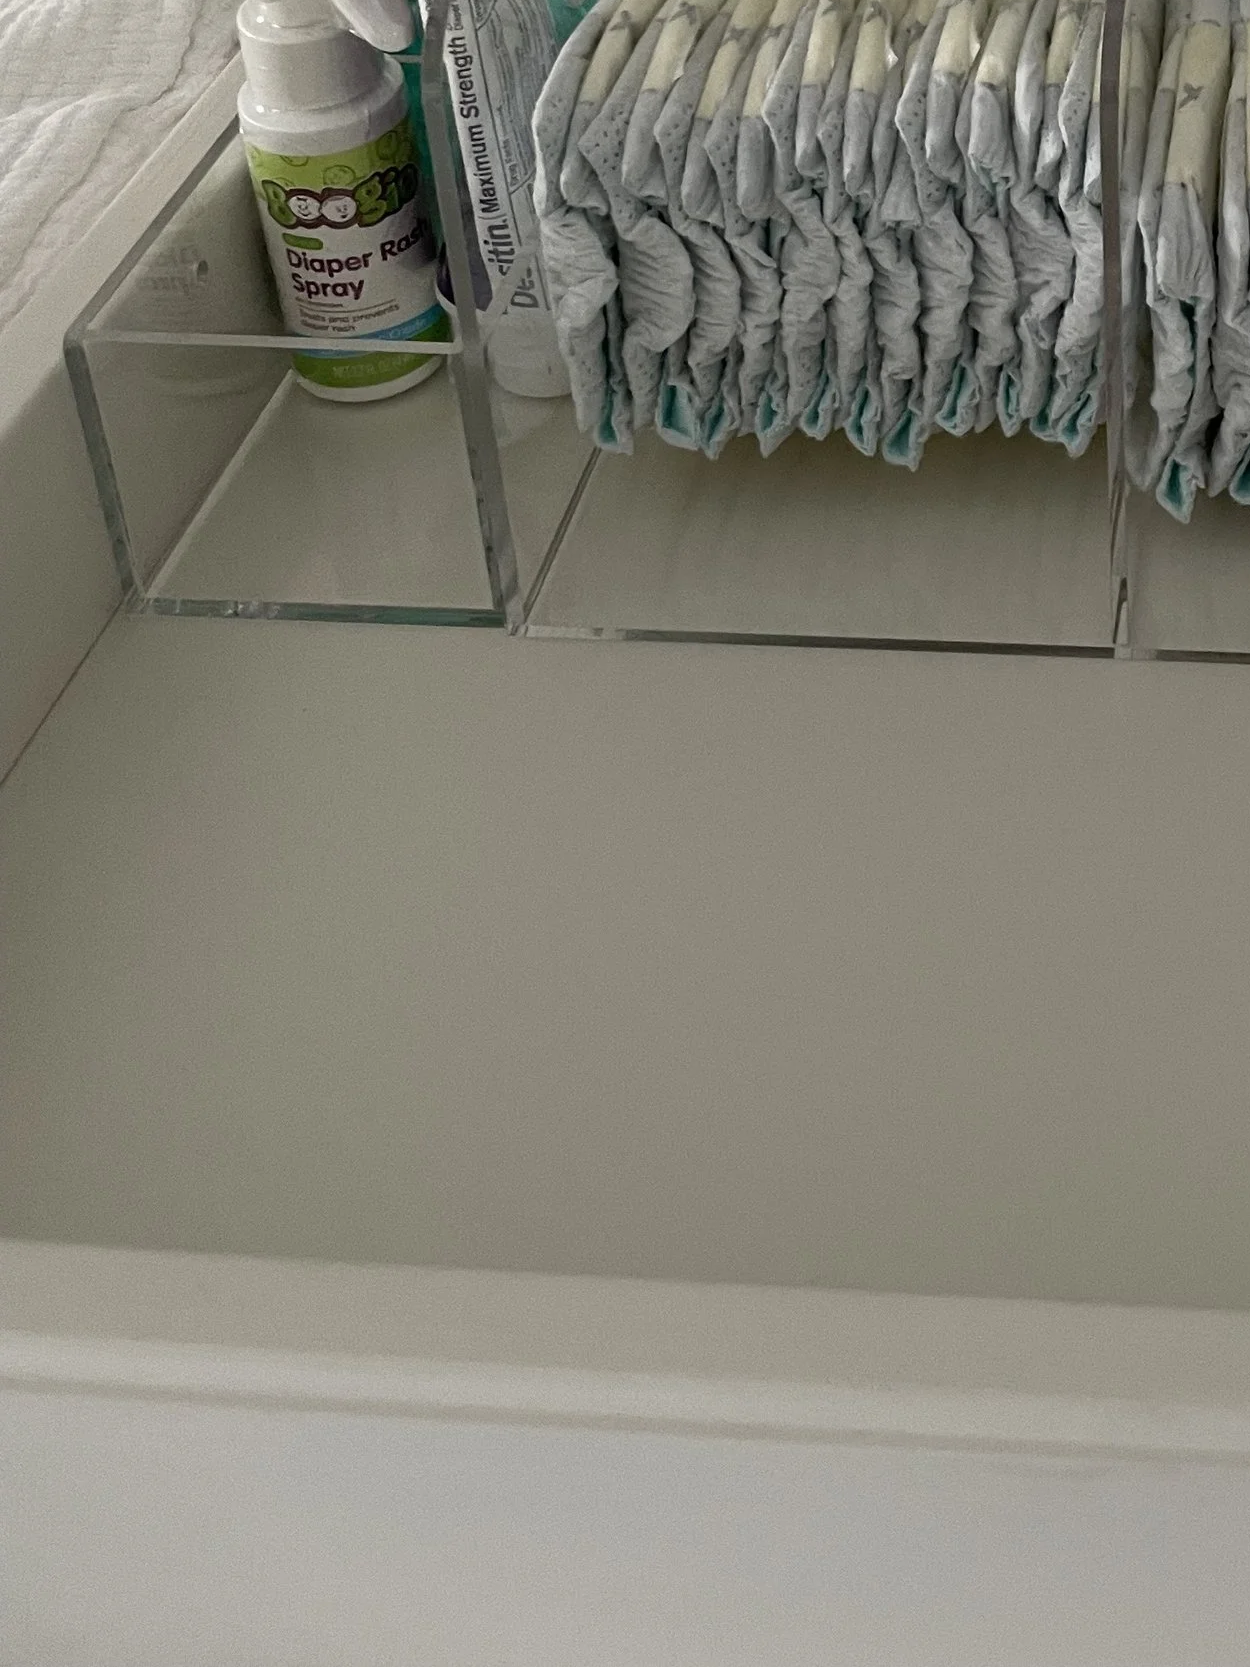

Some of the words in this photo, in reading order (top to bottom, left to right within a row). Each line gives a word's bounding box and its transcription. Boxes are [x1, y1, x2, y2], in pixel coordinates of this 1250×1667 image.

[448, 36, 480, 119] Strength
[470, 124, 500, 213] Maximum
[286, 248, 373, 279] Diaper
[380, 218, 428, 263] Rash
[292, 272, 365, 300] Spray
